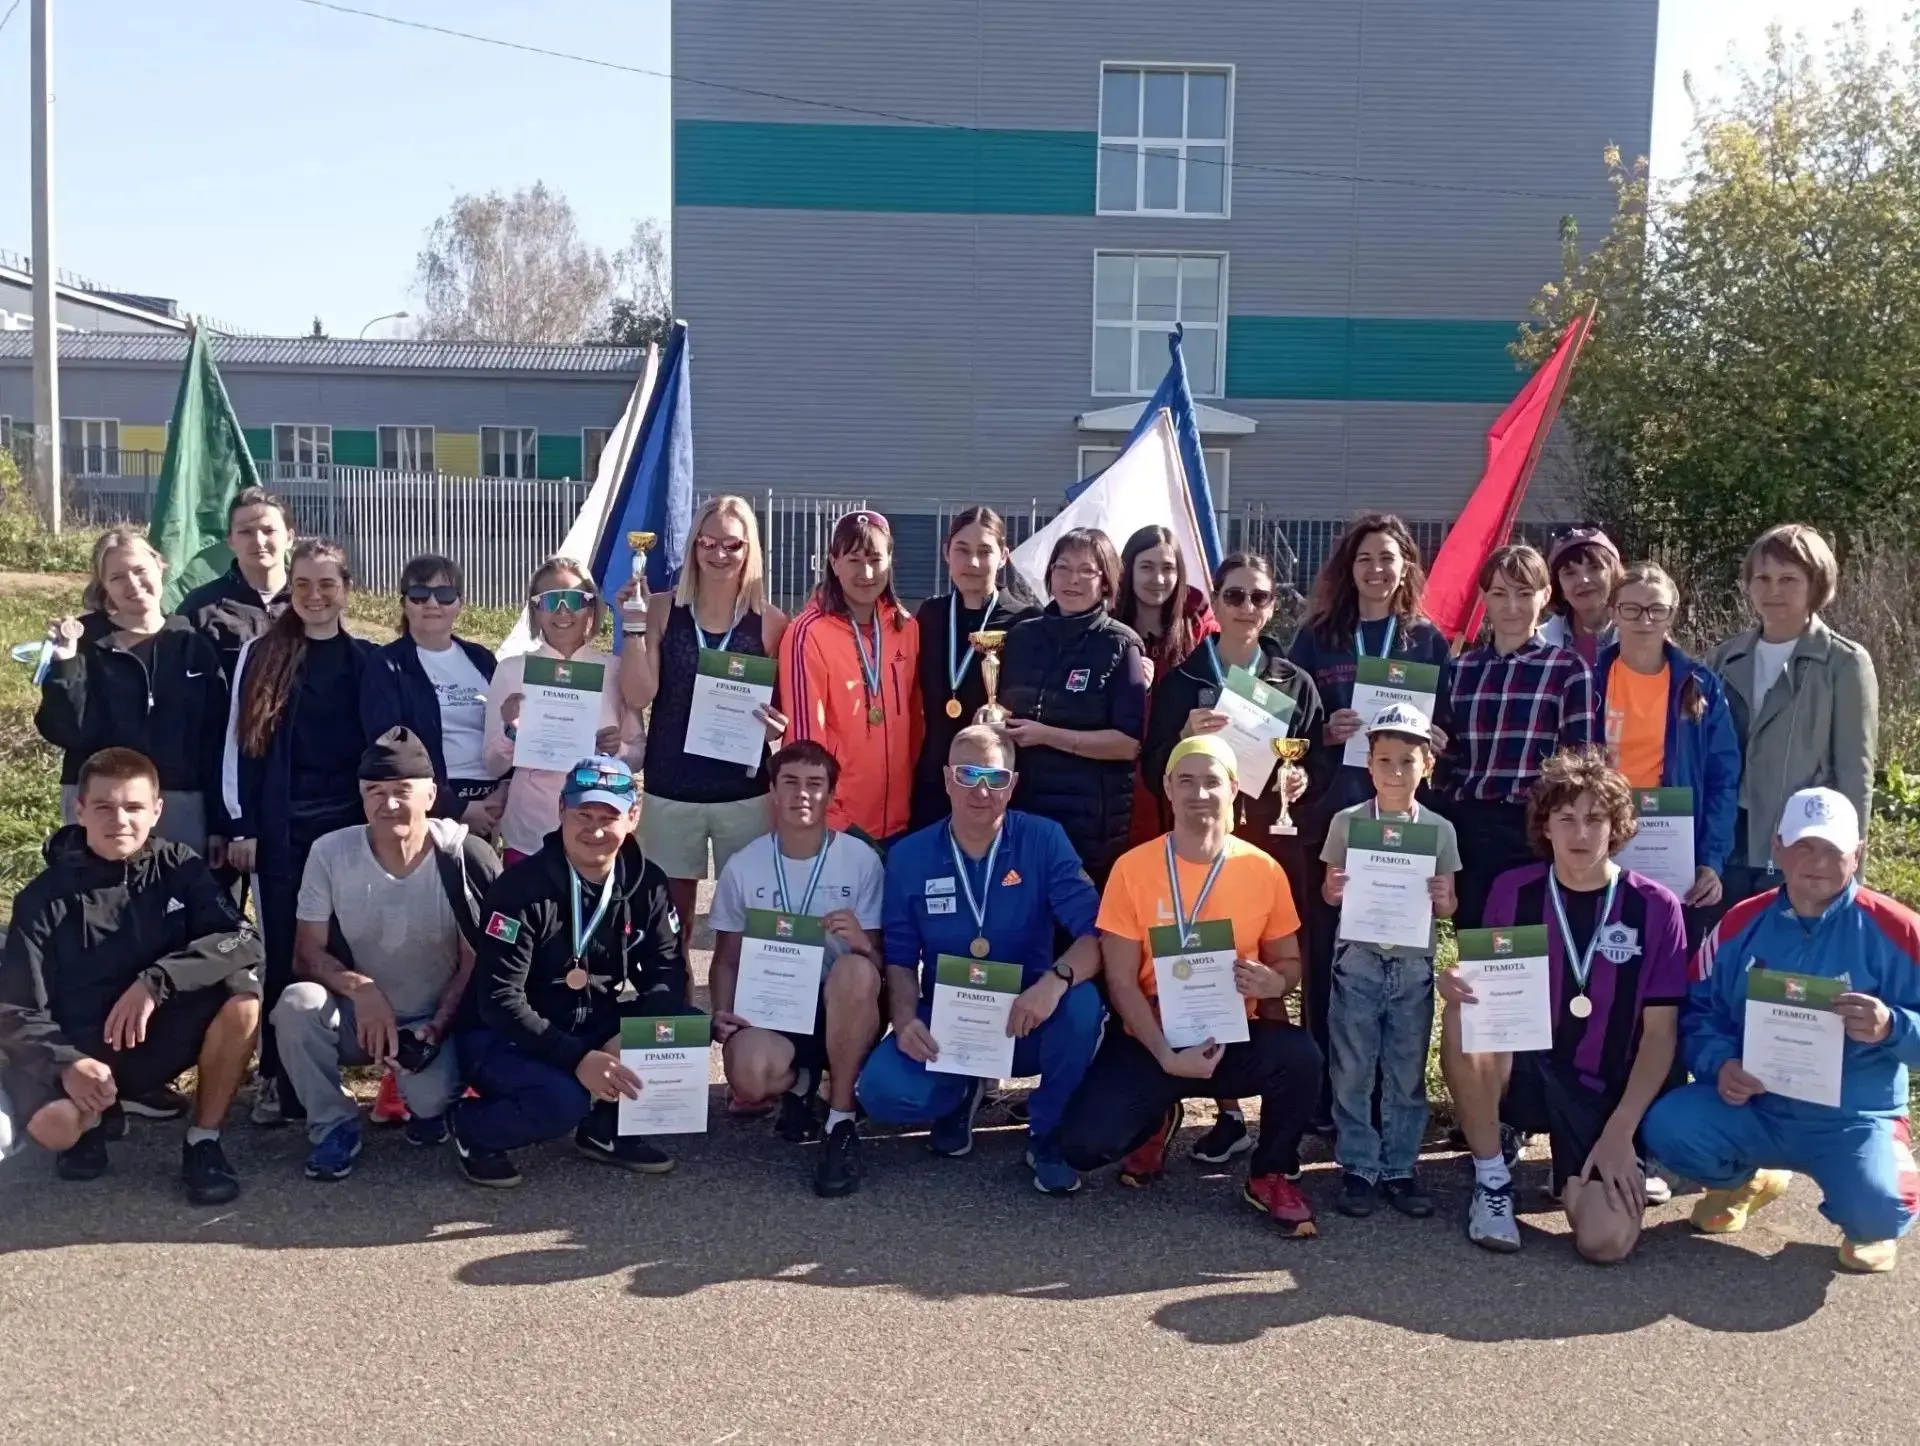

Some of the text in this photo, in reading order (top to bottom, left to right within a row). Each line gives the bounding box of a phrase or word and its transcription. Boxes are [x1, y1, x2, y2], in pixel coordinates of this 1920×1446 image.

[716, 682, 751, 694] ГРАМОТА
[543, 690, 579, 701] ГРАМОТА
[1375, 690, 1412, 701] ГРАМОТА
[1377, 713, 1417, 727] BRAVE
[1370, 855, 1411, 866] ГРАМОТА
[763, 944, 801, 956] ГРАМОТА
[1484, 963, 1526, 972] ГРАМОТА
[957, 991, 996, 1003] ГРАМОТА
[1772, 1008, 1818, 1022] ГРАМОТА
[644, 1052, 686, 1061] ГРАМОТА
